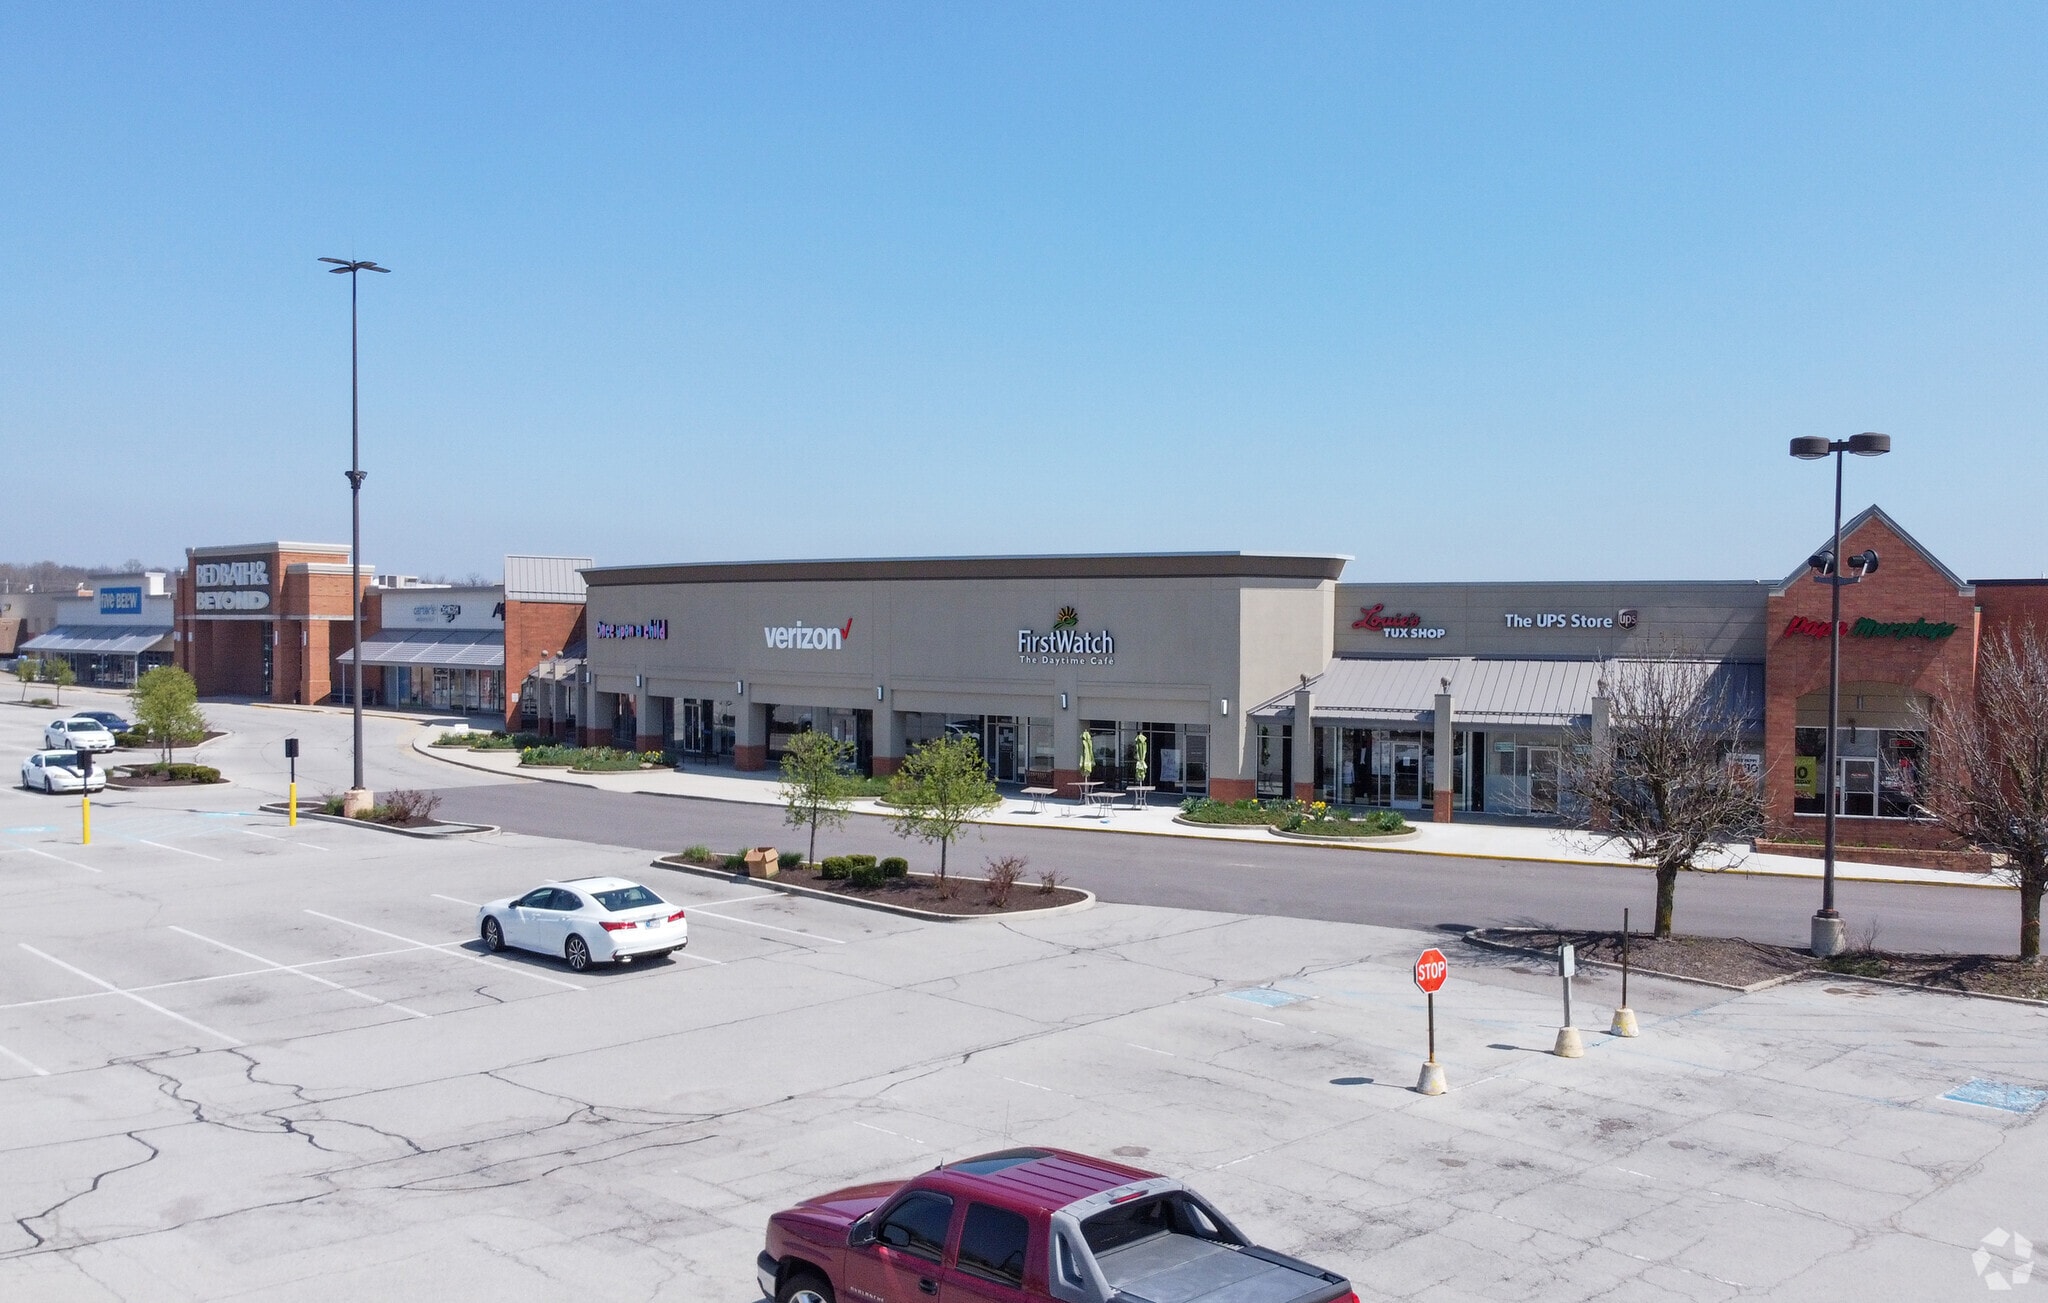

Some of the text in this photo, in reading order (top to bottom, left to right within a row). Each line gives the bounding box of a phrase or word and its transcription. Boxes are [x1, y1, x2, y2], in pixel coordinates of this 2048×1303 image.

[196, 560, 269, 587] BED BATH &
[196, 590, 269, 610] BEYOND
[1352, 603, 1421, 632] Louie's
[1504, 613, 1613, 628] The UPS Store
[1619, 615, 1637, 627] ups
[597, 619, 668, 640] Once upon a child
[764, 620, 842, 650] verizon
[1383, 627, 1446, 639] TUX SHOP
[1019, 655, 1114, 666] The Daytime Café
[1418, 961, 1445, 981] STOP
